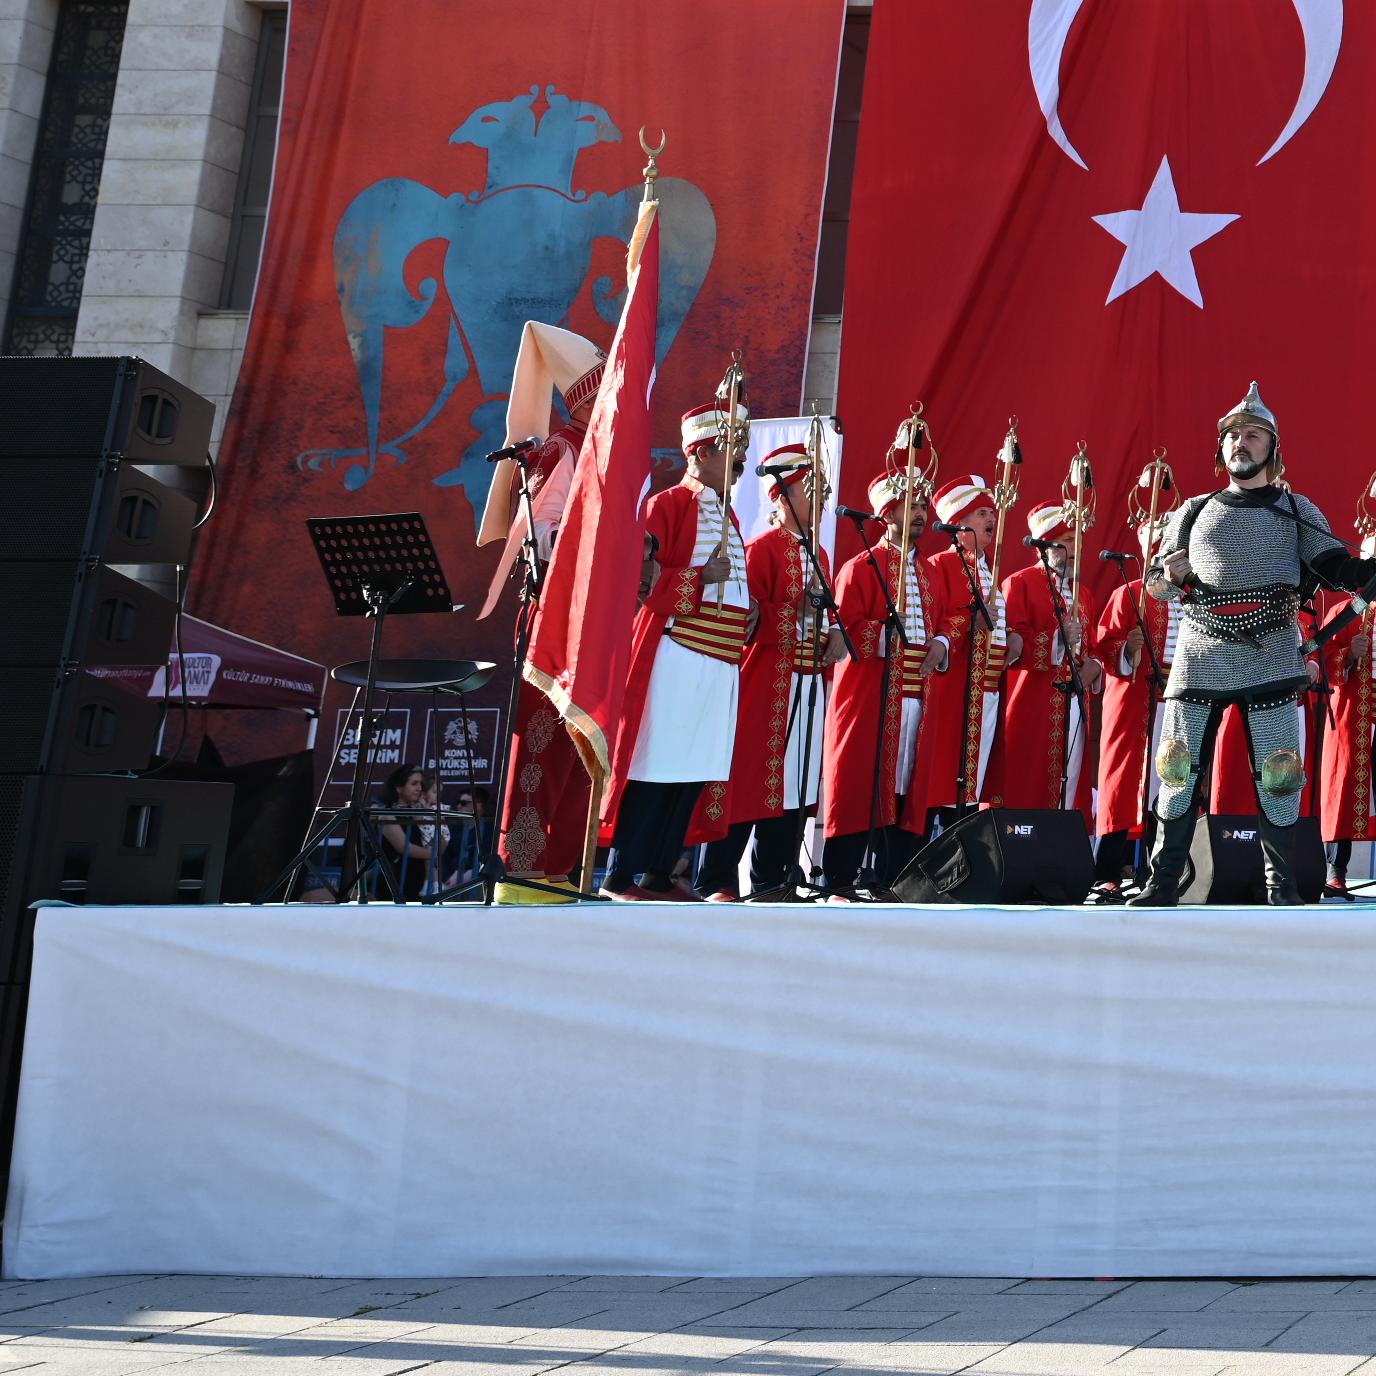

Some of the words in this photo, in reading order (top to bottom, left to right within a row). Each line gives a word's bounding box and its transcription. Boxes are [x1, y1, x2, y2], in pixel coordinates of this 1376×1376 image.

[187, 670, 211, 685] ANAT
[1014, 825, 1034, 835] NET
[1232, 830, 1257, 840] NET
